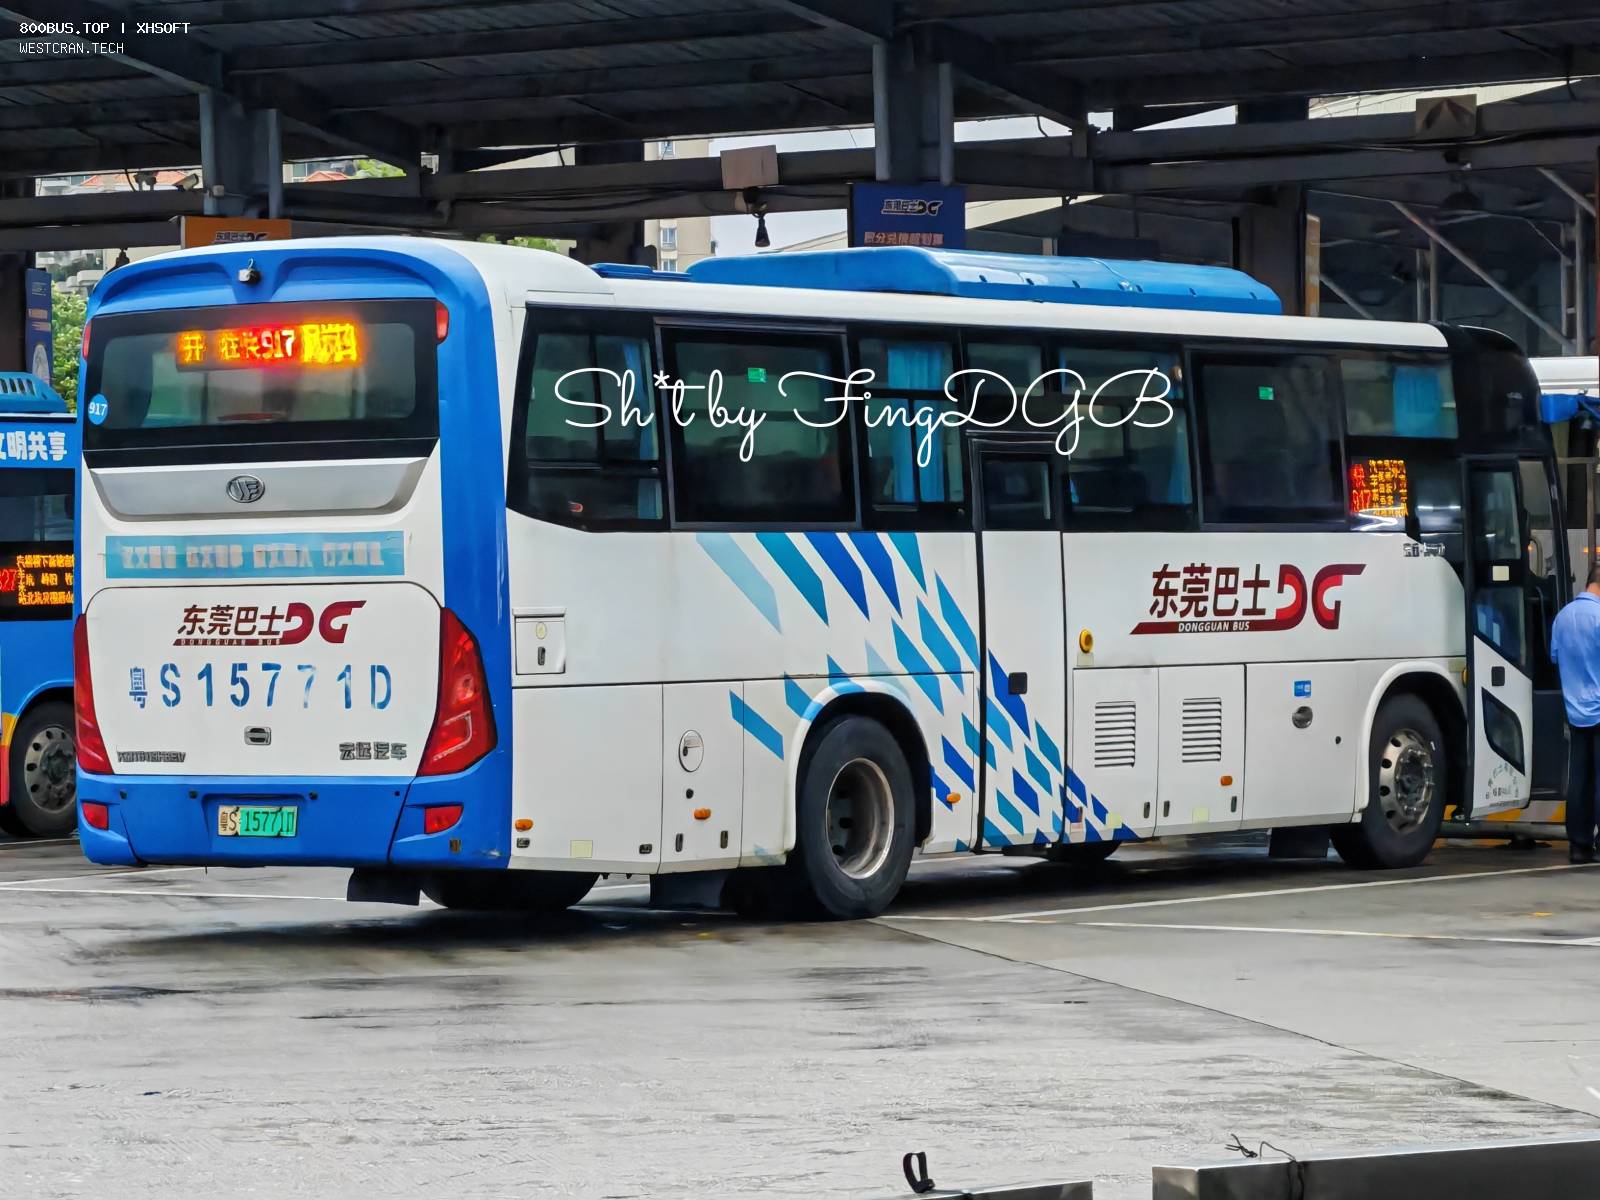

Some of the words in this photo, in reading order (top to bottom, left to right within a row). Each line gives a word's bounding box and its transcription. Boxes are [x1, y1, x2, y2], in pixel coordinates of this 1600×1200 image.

[88, 402, 108, 416] 917
[0, 568, 17, 592] 27
[1149, 563, 1271, 619] 东莞巴士
[1274, 564, 1367, 630] DG
[177, 604, 285, 636] 东莞巴士
[282, 600, 367, 646] DG
[1178, 621, 1229, 633] DONGGUAN
[1232, 621, 1250, 632] BUS
[129, 662, 392, 710] 粤S15771D
